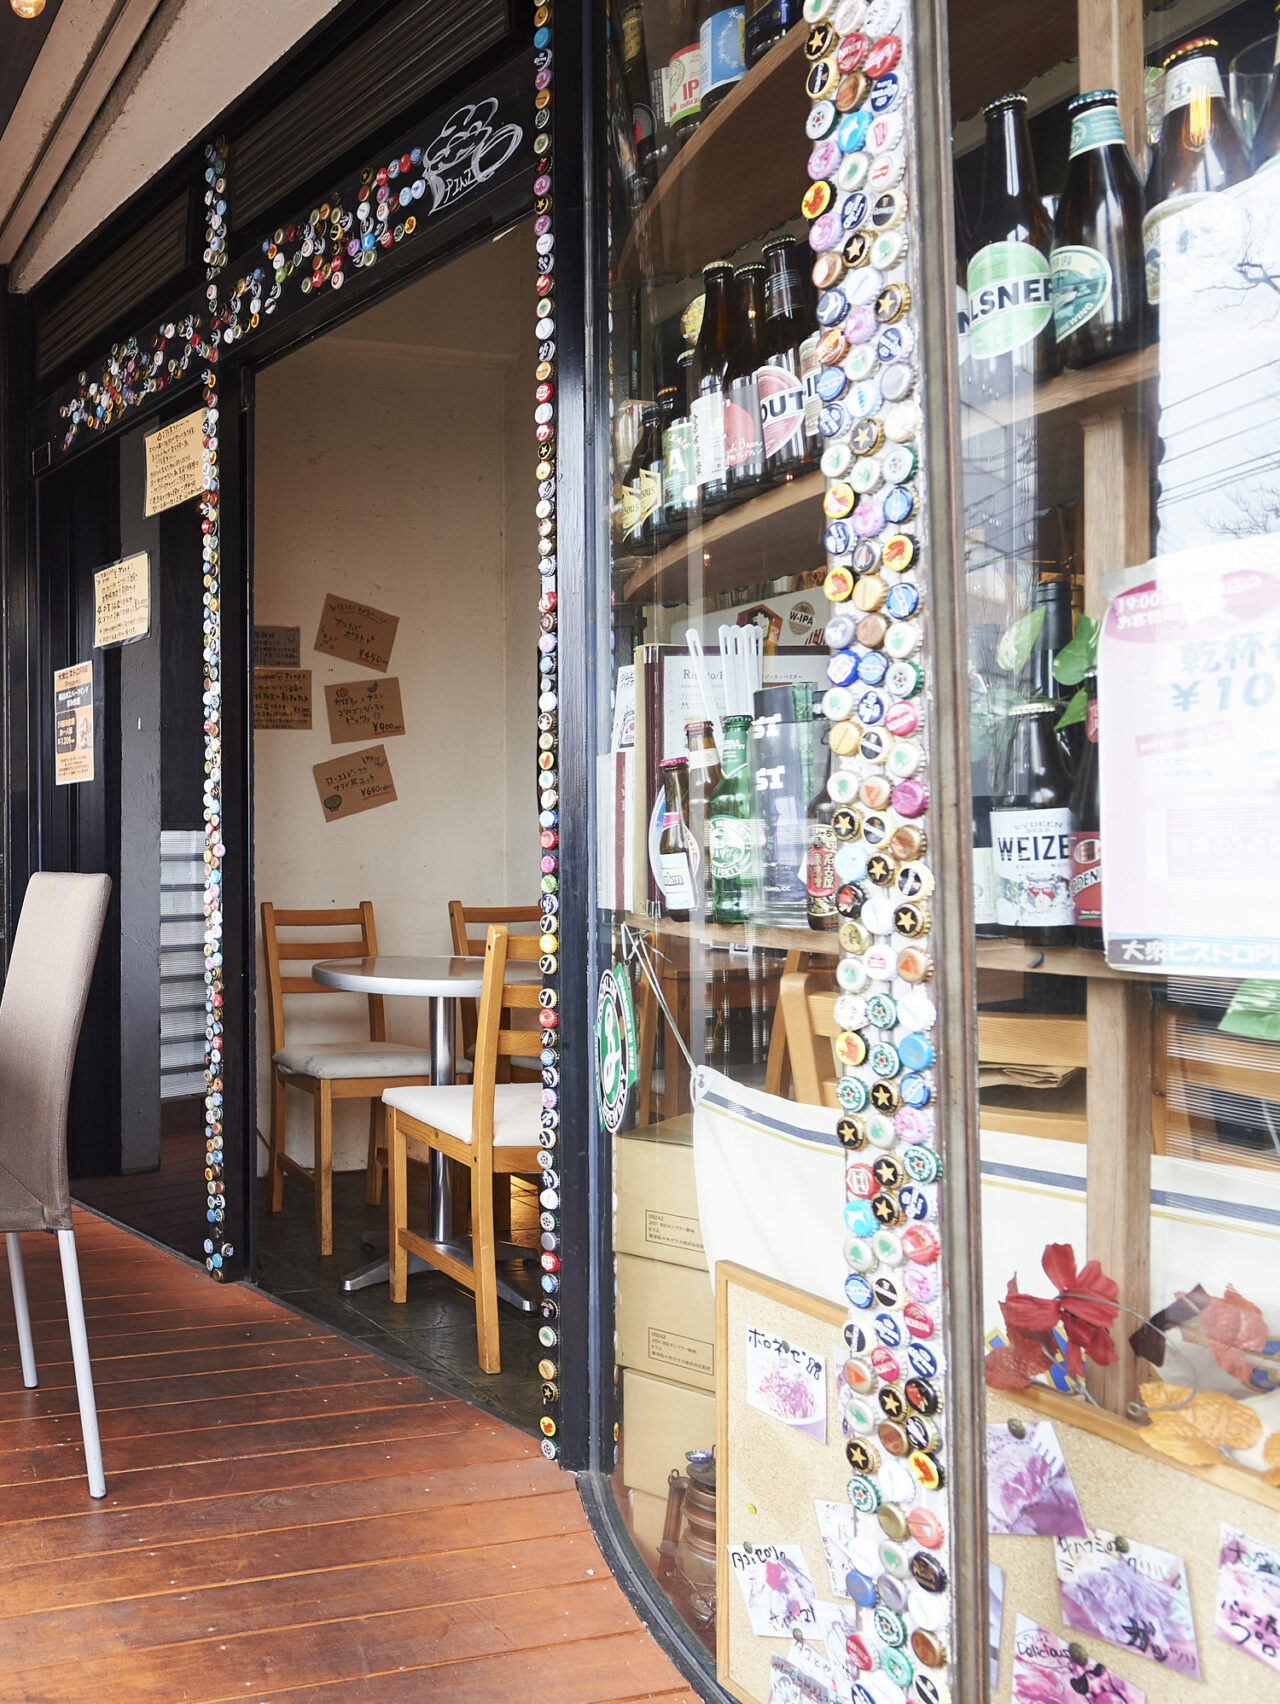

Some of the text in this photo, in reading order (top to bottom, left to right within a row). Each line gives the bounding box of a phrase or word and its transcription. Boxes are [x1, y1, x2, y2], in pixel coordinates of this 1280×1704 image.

[682, 80, 700, 101] IP
[789, 611, 814, 625] W-IPA
[997, 834, 1069, 862] WEIZE
